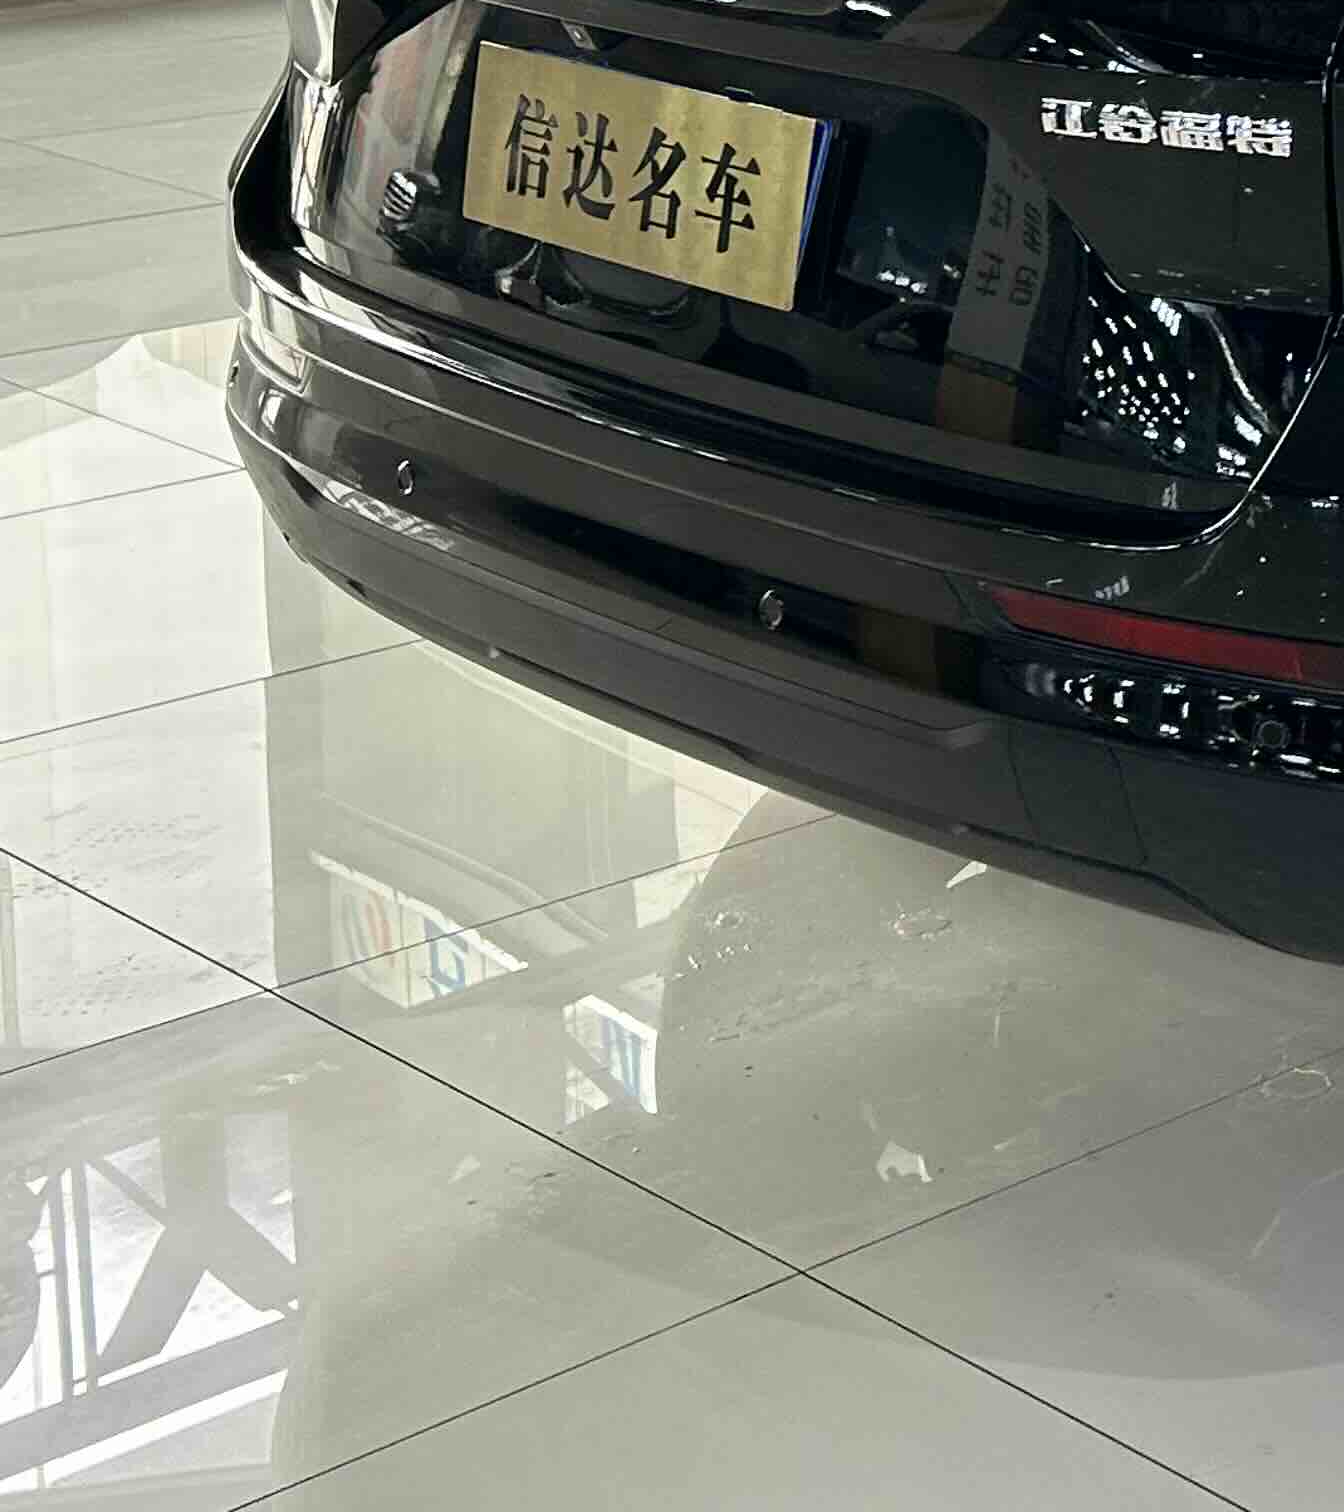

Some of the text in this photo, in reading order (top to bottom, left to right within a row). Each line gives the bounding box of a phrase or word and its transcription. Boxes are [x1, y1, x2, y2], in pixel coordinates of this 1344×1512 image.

[503, 94, 762, 254] 信达名车
[1040, 97, 1293, 159] 江铃福特
